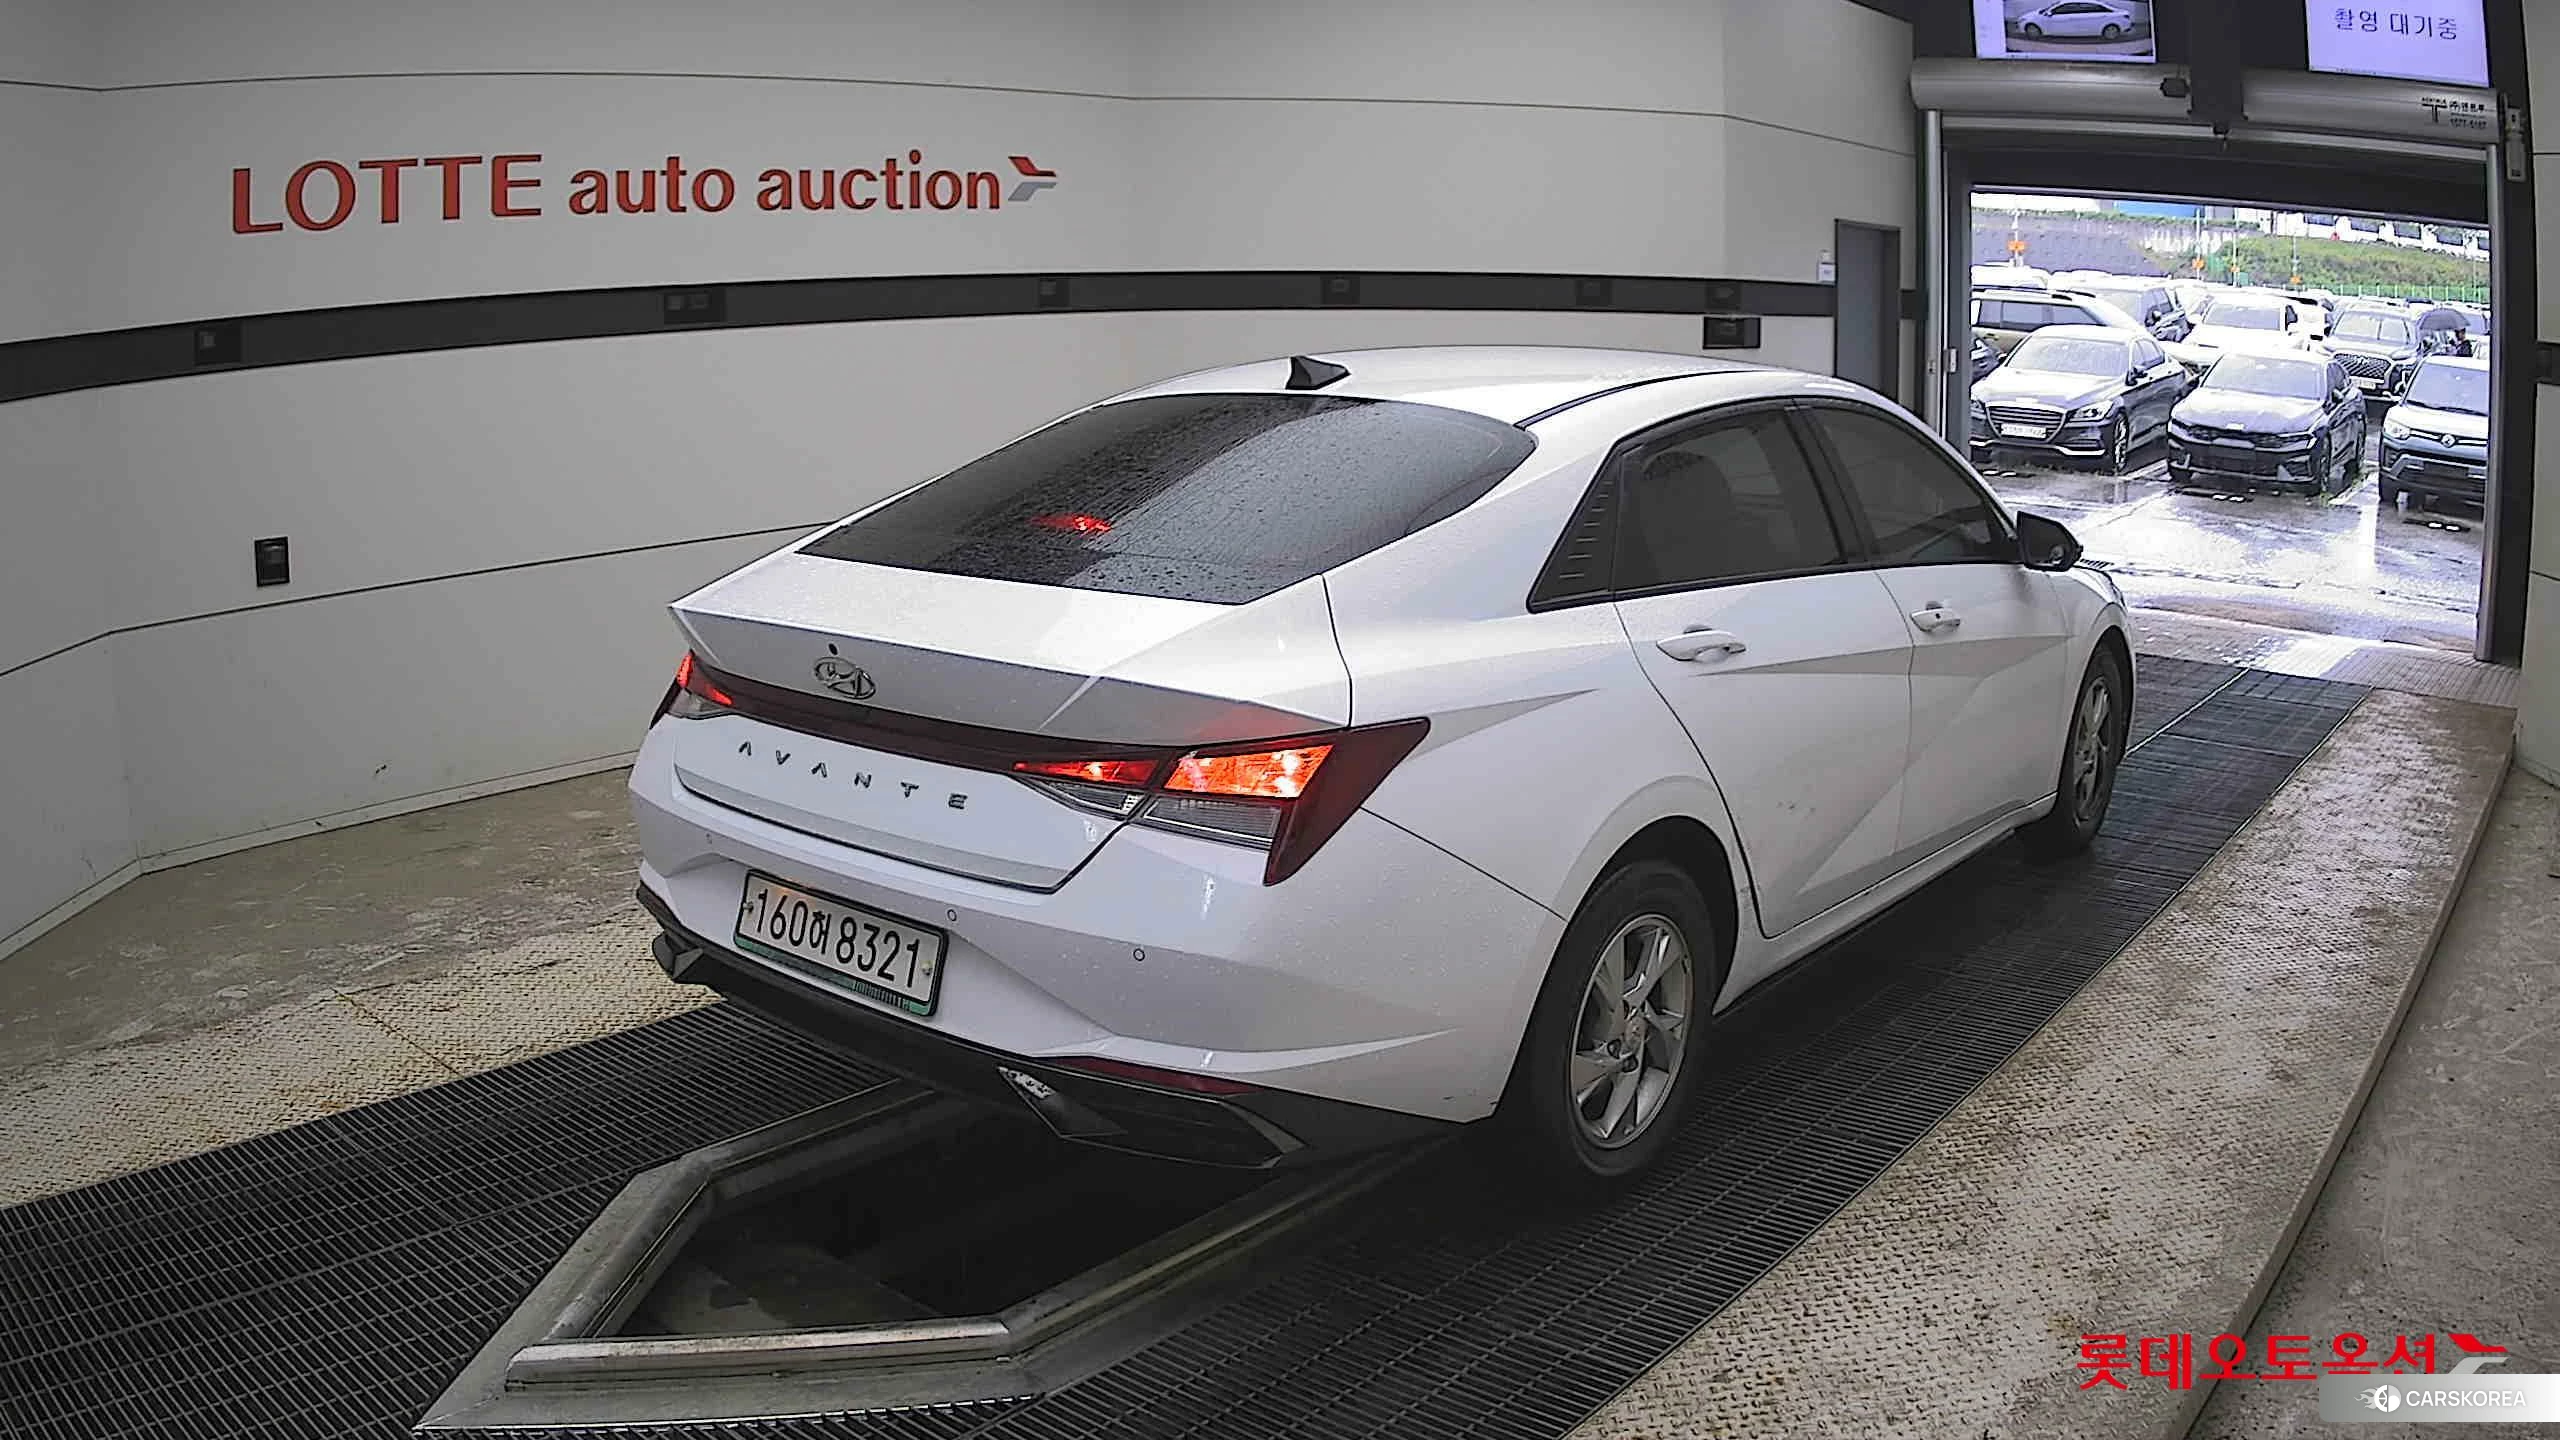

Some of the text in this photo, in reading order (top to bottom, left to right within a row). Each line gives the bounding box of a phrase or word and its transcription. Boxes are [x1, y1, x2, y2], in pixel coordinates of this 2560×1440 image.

[2335, 8, 2457, 41] 촬영 대기중
[232, 149, 1002, 234] LOTTE auto auction
[737, 740, 969, 810] AVANTE
[756, 888, 921, 989] 160허8321
